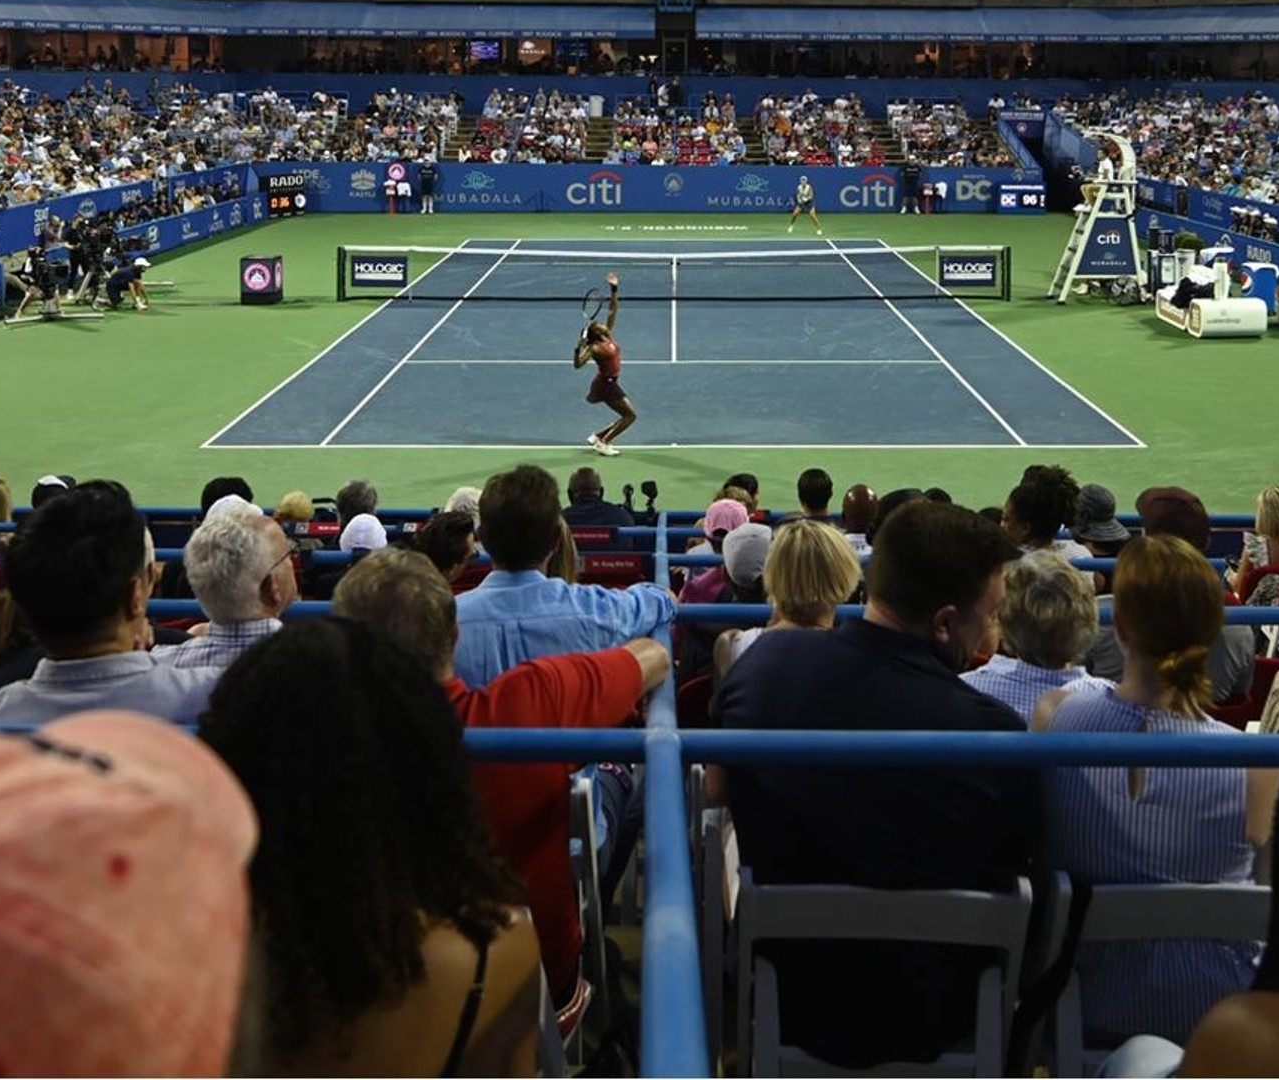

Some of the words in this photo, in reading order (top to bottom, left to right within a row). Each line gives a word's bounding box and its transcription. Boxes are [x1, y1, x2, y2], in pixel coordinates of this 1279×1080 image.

[270, 175, 303, 188] RADO
[566, 170, 623, 205] citi
[839, 173, 896, 208] citi
[955, 180, 993, 201] DC
[434, 193, 522, 205] MUBADALA
[1022, 194, 1038, 206] 96
[1097, 230, 1120, 245] citi
[1246, 246, 1272, 264] RADO
[353, 263, 405, 273] HOLOGIC
[943, 262, 993, 273] HOLOGIC
